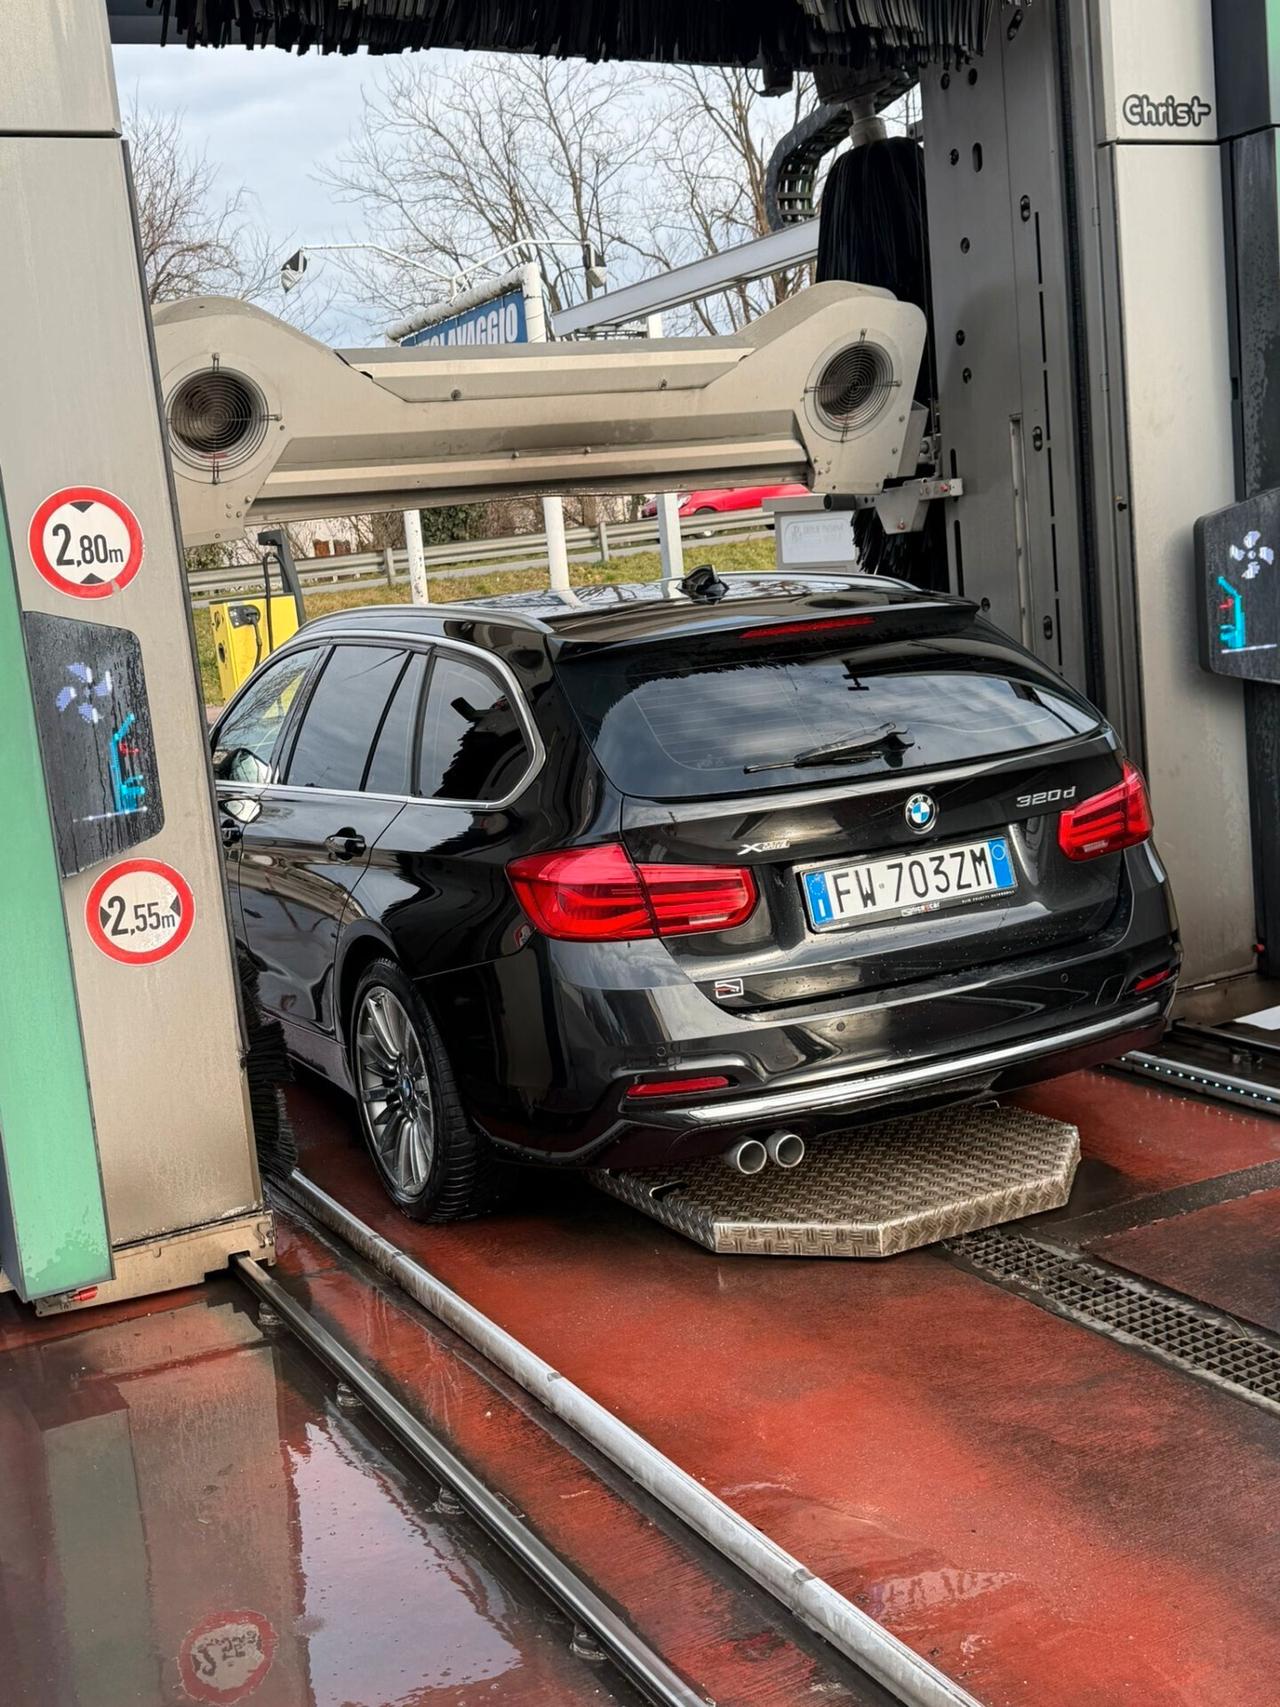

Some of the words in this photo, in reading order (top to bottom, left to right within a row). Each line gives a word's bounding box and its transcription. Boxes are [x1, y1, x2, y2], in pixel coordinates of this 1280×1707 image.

[1123, 94, 1211, 127] Christ
[52, 523, 124, 568] 2,80m
[1016, 785, 1076, 807] 320d
[832, 872, 876, 913] FW
[886, 847, 992, 903] 703ZM
[107, 895, 176, 937] 2,55m
